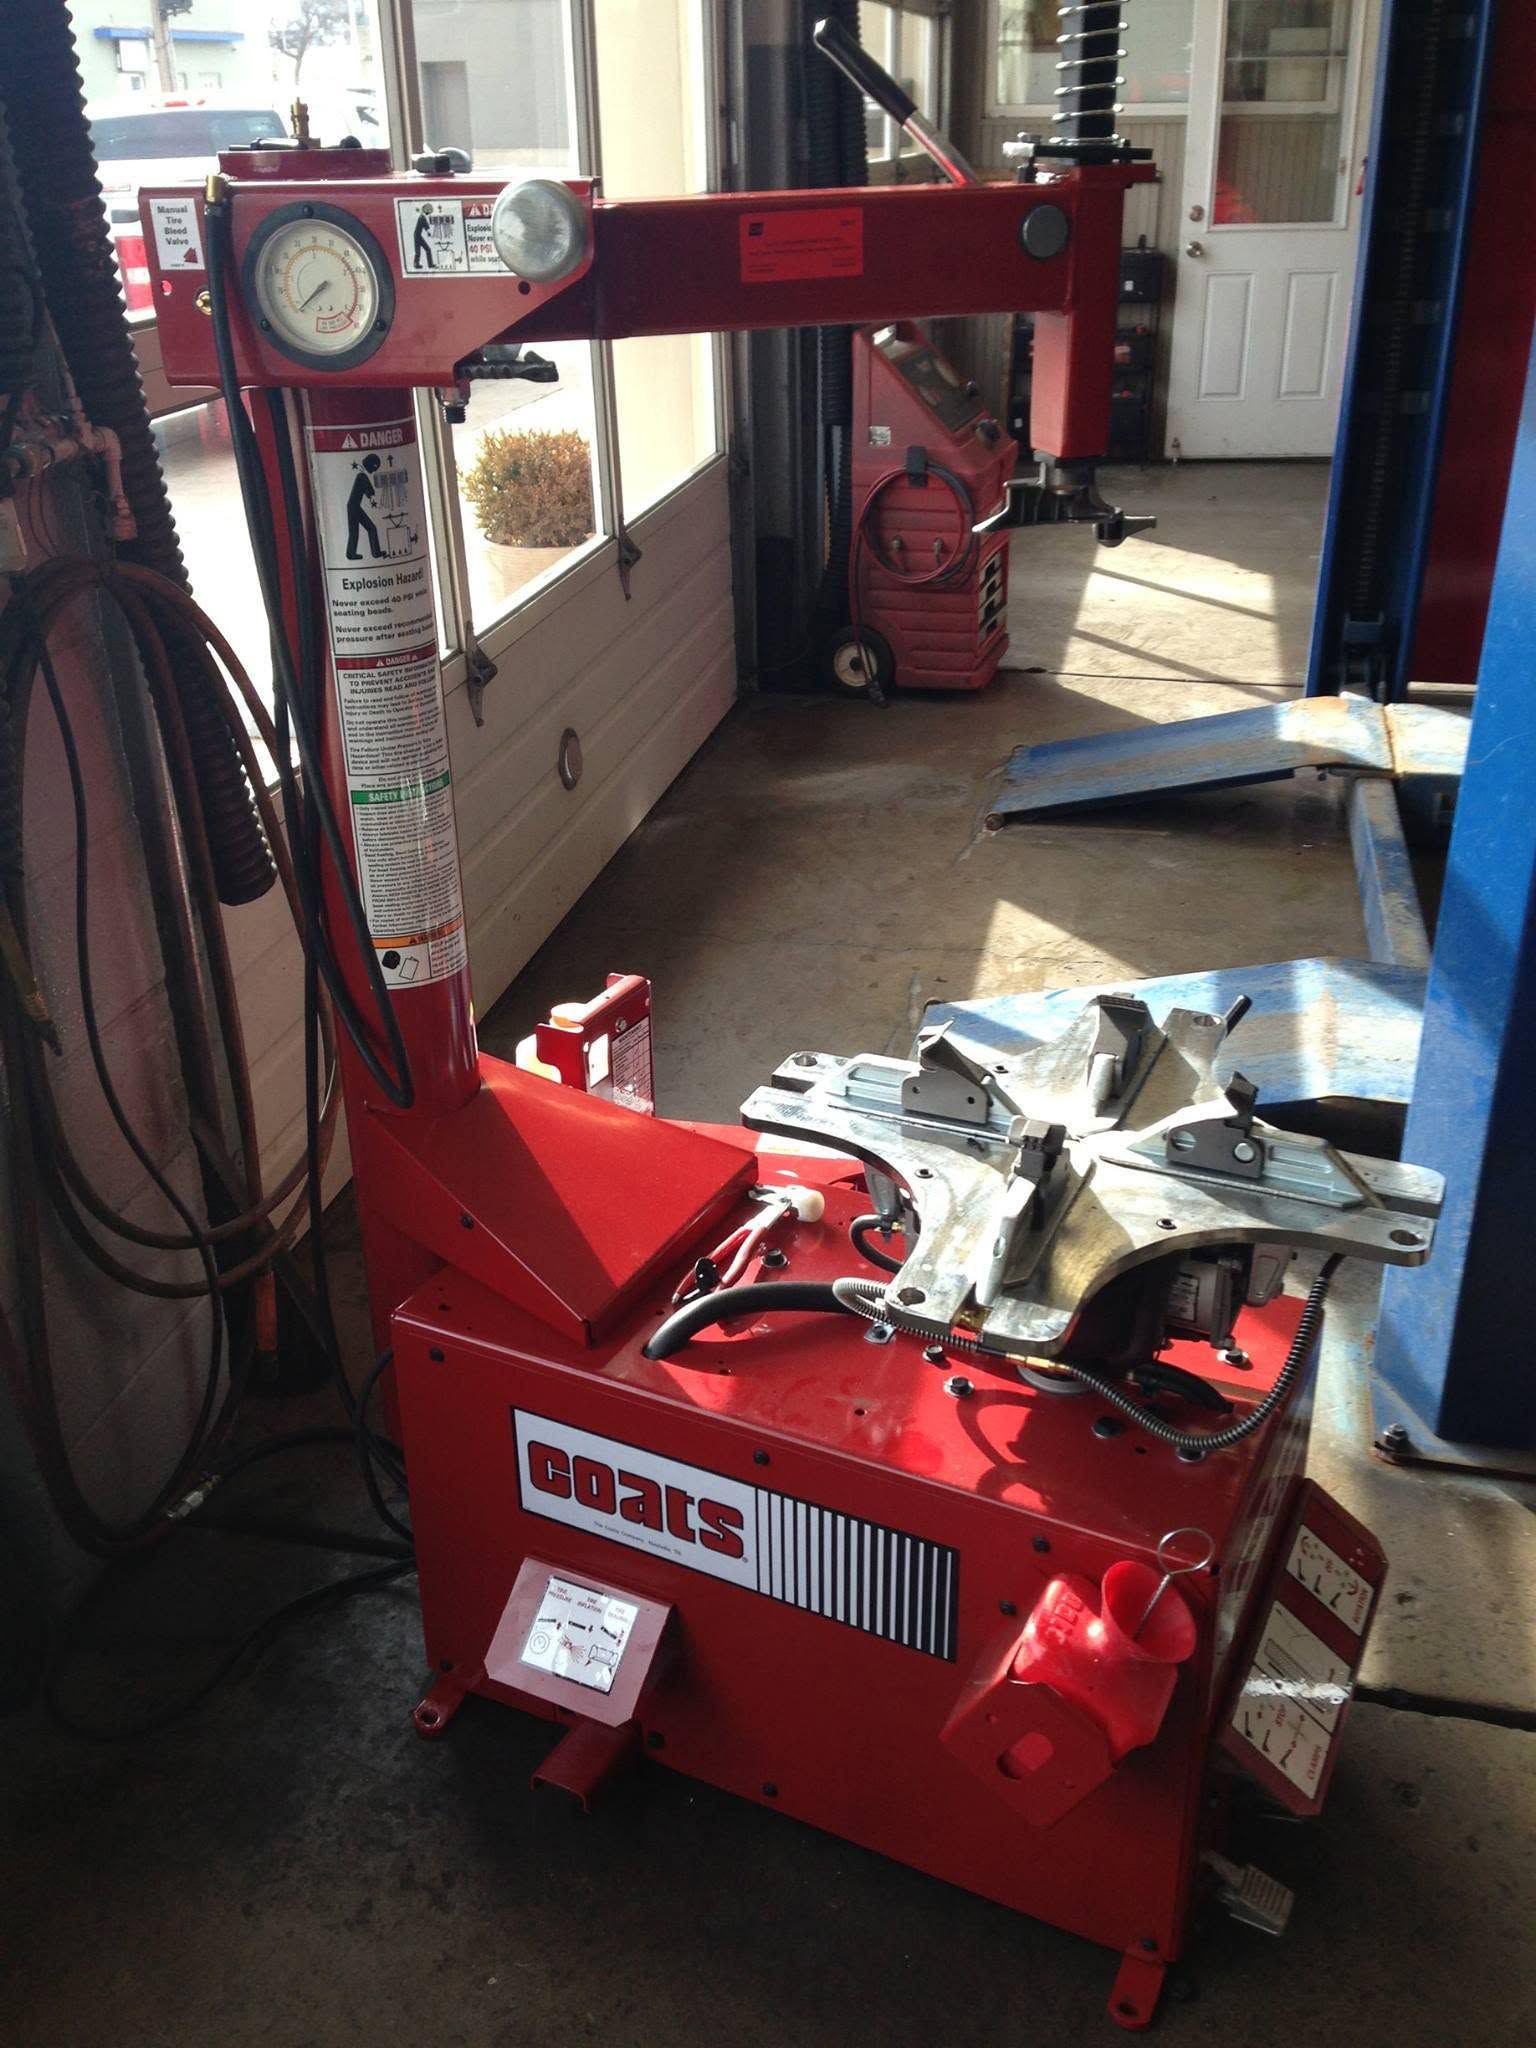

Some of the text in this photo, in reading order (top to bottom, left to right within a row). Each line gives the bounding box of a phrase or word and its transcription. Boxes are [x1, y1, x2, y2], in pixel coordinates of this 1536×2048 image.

[157, 205, 188, 214] Manual
[165, 216, 182, 224] Tire
[164, 226, 187, 235] Bleed
[165, 237, 189, 246] Valve
[469, 243, 493, 254] 40 PSI
[470, 255, 486, 263] while
[361, 428, 404, 449] DANGER
[342, 567, 425, 592] Explosion Hazard!
[332, 599, 357, 608] Never
[360, 596, 390, 606] exceed
[391, 595, 402, 603] 40
[333, 608, 366, 617] seating
[335, 625, 361, 633] Never
[363, 623, 393, 632] exceed
[336, 636, 374, 644] pressure
[375, 632, 396, 642] after
[385, 654, 411, 667] DANGER
[343, 672, 376, 680] CRITICAL
[378, 669, 404, 678] SAFETY
[361, 679, 393, 687] PREVENT
[384, 685, 403, 693] READ
[404, 681, 418, 689] AND
[368, 793, 398, 802] SAFETY
[548, 1590, 572, 1604] PRESSURE
[586, 1596, 598, 1605] TIRE
[577, 1600, 603, 1614] INFLATION
[1307, 1744, 1323, 1781] CLAMP
